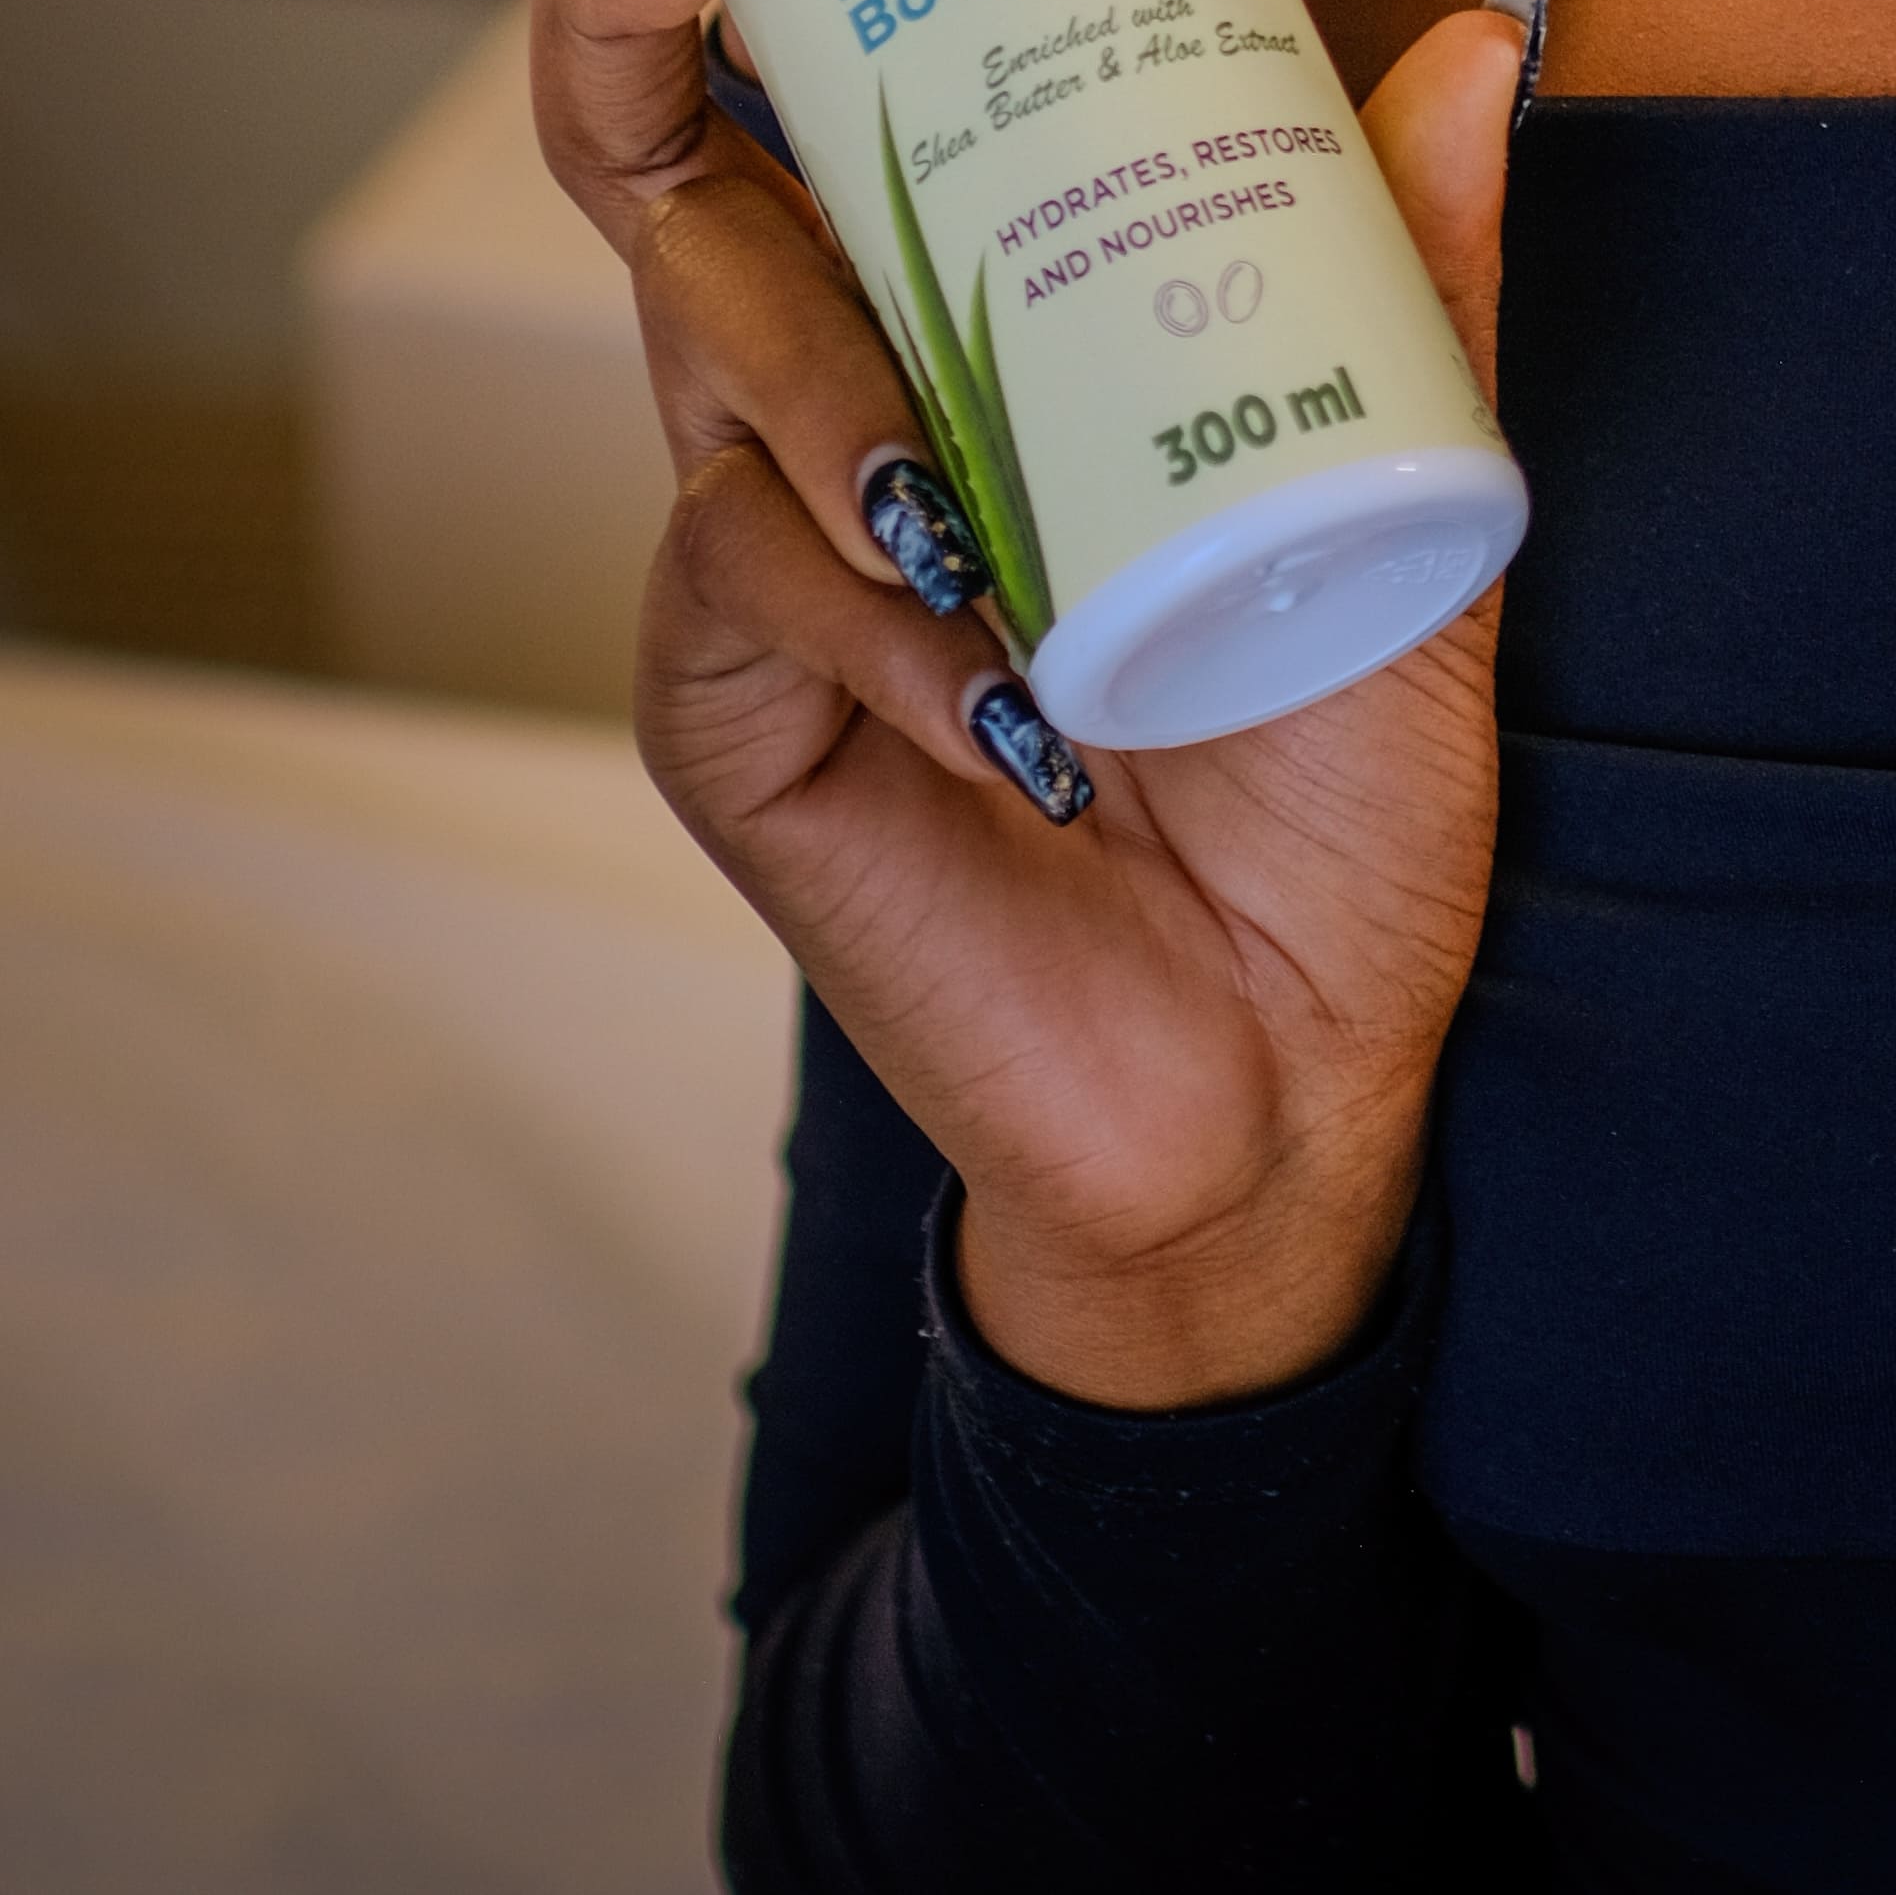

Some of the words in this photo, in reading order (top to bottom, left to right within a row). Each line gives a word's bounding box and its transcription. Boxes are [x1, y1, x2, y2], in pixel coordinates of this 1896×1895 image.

[912, 126, 977, 185] Shea
[984, 71, 1086, 130] Butter
[1098, 46, 1121, 82] &
[1136, 34, 1205, 74] Aloe
[1214, 21, 1299, 57] Extract
[982, 7, 1119, 90] Enriched
[995, 152, 1189, 256] HYDRATES,
[1192, 126, 1342, 169] RESTORES
[1023, 249, 1092, 308] AND
[1098, 180, 1297, 264] NOURISHES
[1152, 394, 1278, 487] 300
[1285, 366, 1367, 433] ml
